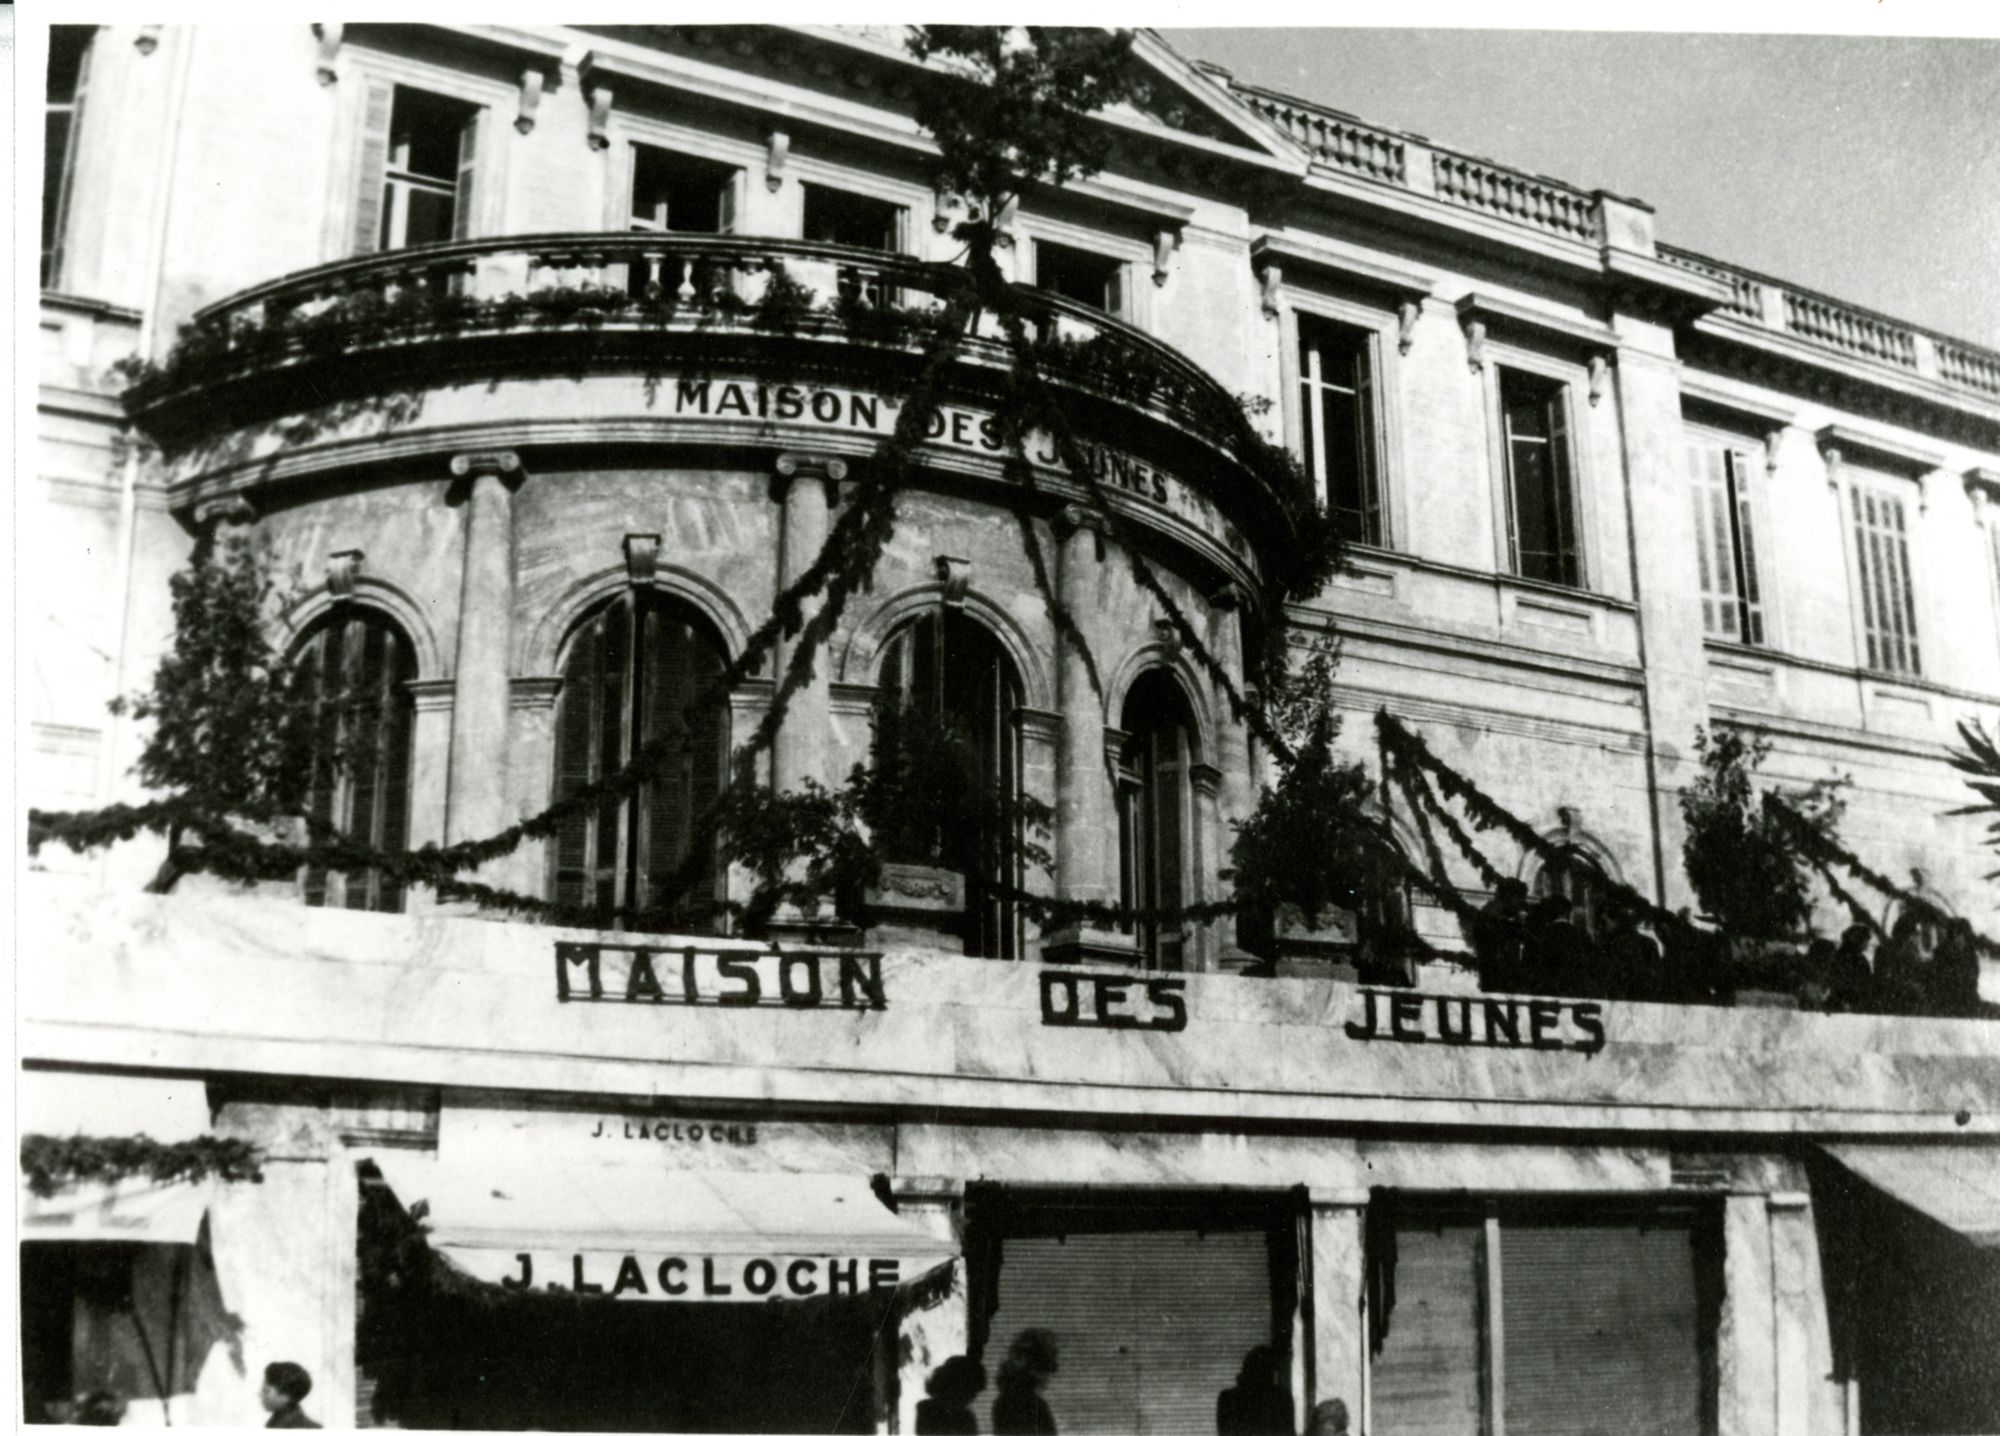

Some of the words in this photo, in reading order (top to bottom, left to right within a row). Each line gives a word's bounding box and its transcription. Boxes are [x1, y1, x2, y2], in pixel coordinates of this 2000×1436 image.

[676, 379, 878, 429] MAISON
[1037, 431, 1167, 504] JUNES
[556, 942, 888, 1011] MAISON
[1040, 971, 1187, 1032] DES
[1345, 988, 1604, 1052] JEUNES
[624, 1121, 757, 1146] LACLOCHE
